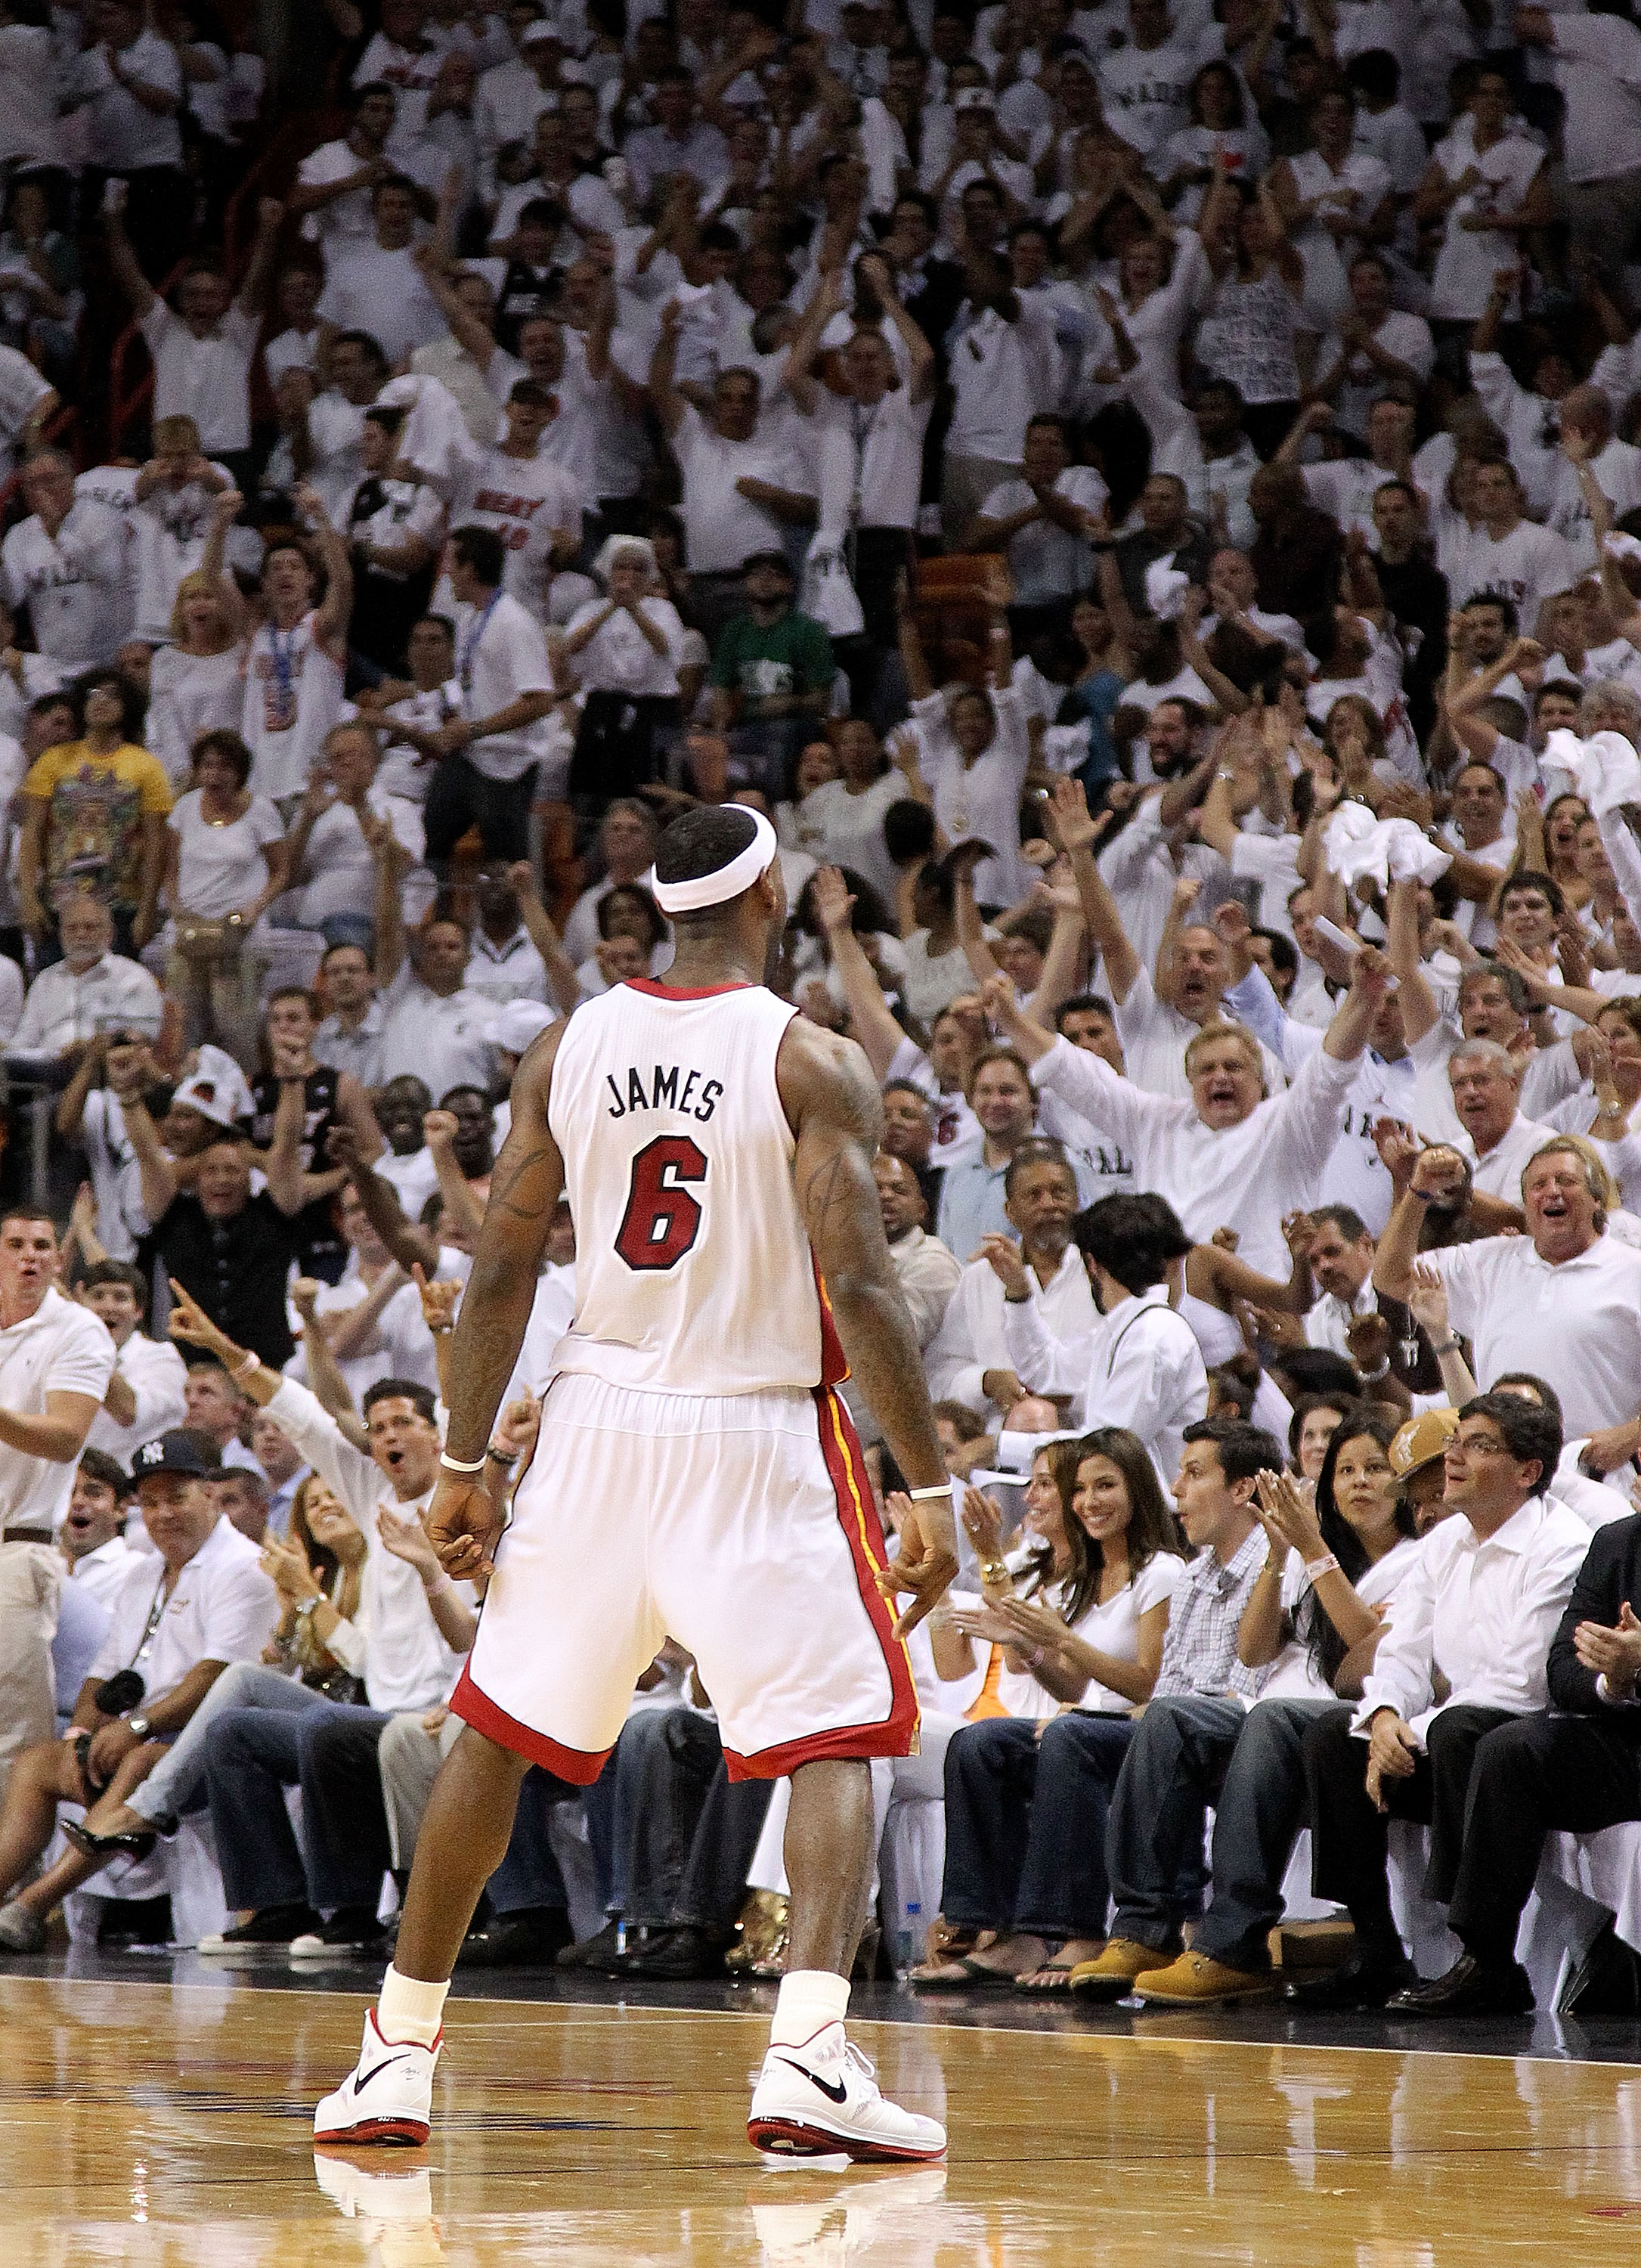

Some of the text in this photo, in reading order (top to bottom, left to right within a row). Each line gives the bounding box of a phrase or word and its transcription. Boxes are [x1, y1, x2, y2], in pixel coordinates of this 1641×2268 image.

[606, 1064, 724, 1123] JAMES
[613, 1134, 708, 1271] 6
[141, 1440, 166, 1465] NY
